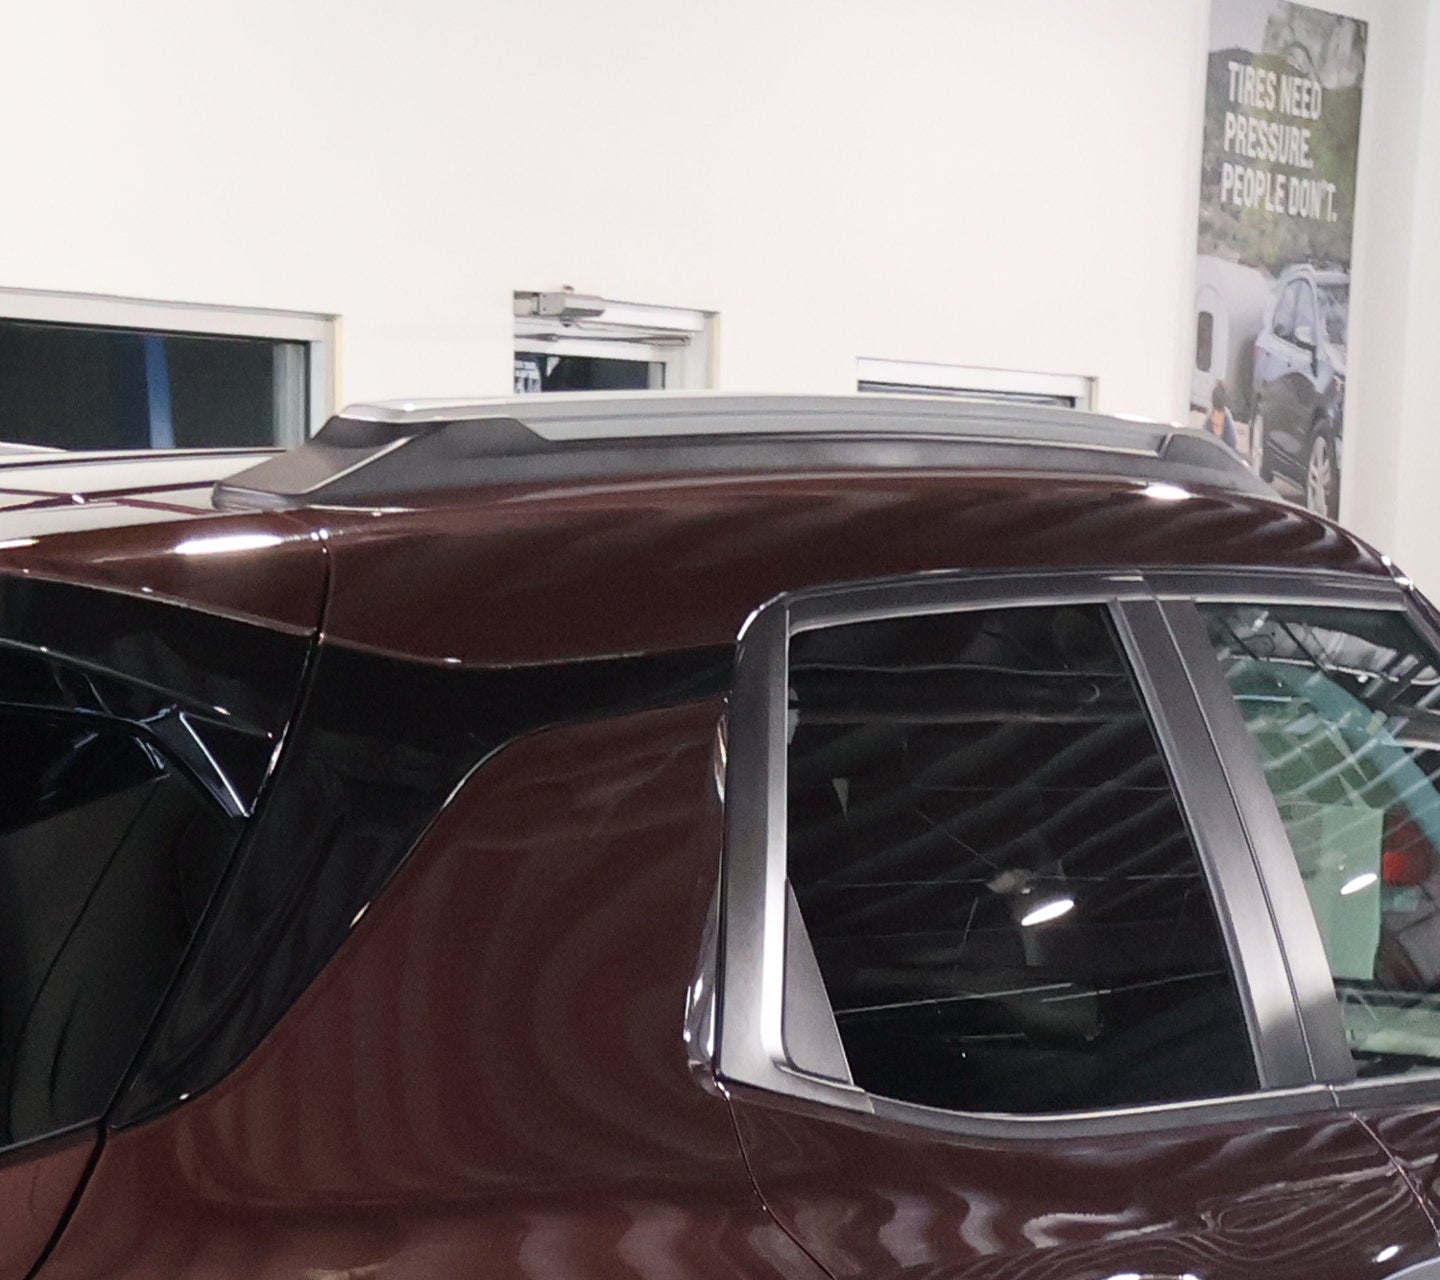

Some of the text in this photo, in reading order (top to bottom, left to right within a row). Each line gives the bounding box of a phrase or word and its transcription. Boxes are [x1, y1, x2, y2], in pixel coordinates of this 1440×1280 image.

[1228, 61, 1323, 120] TIRES NEED
[1224, 111, 1313, 169] PRESSURE.
[1221, 162, 1287, 213] PEOPLE
